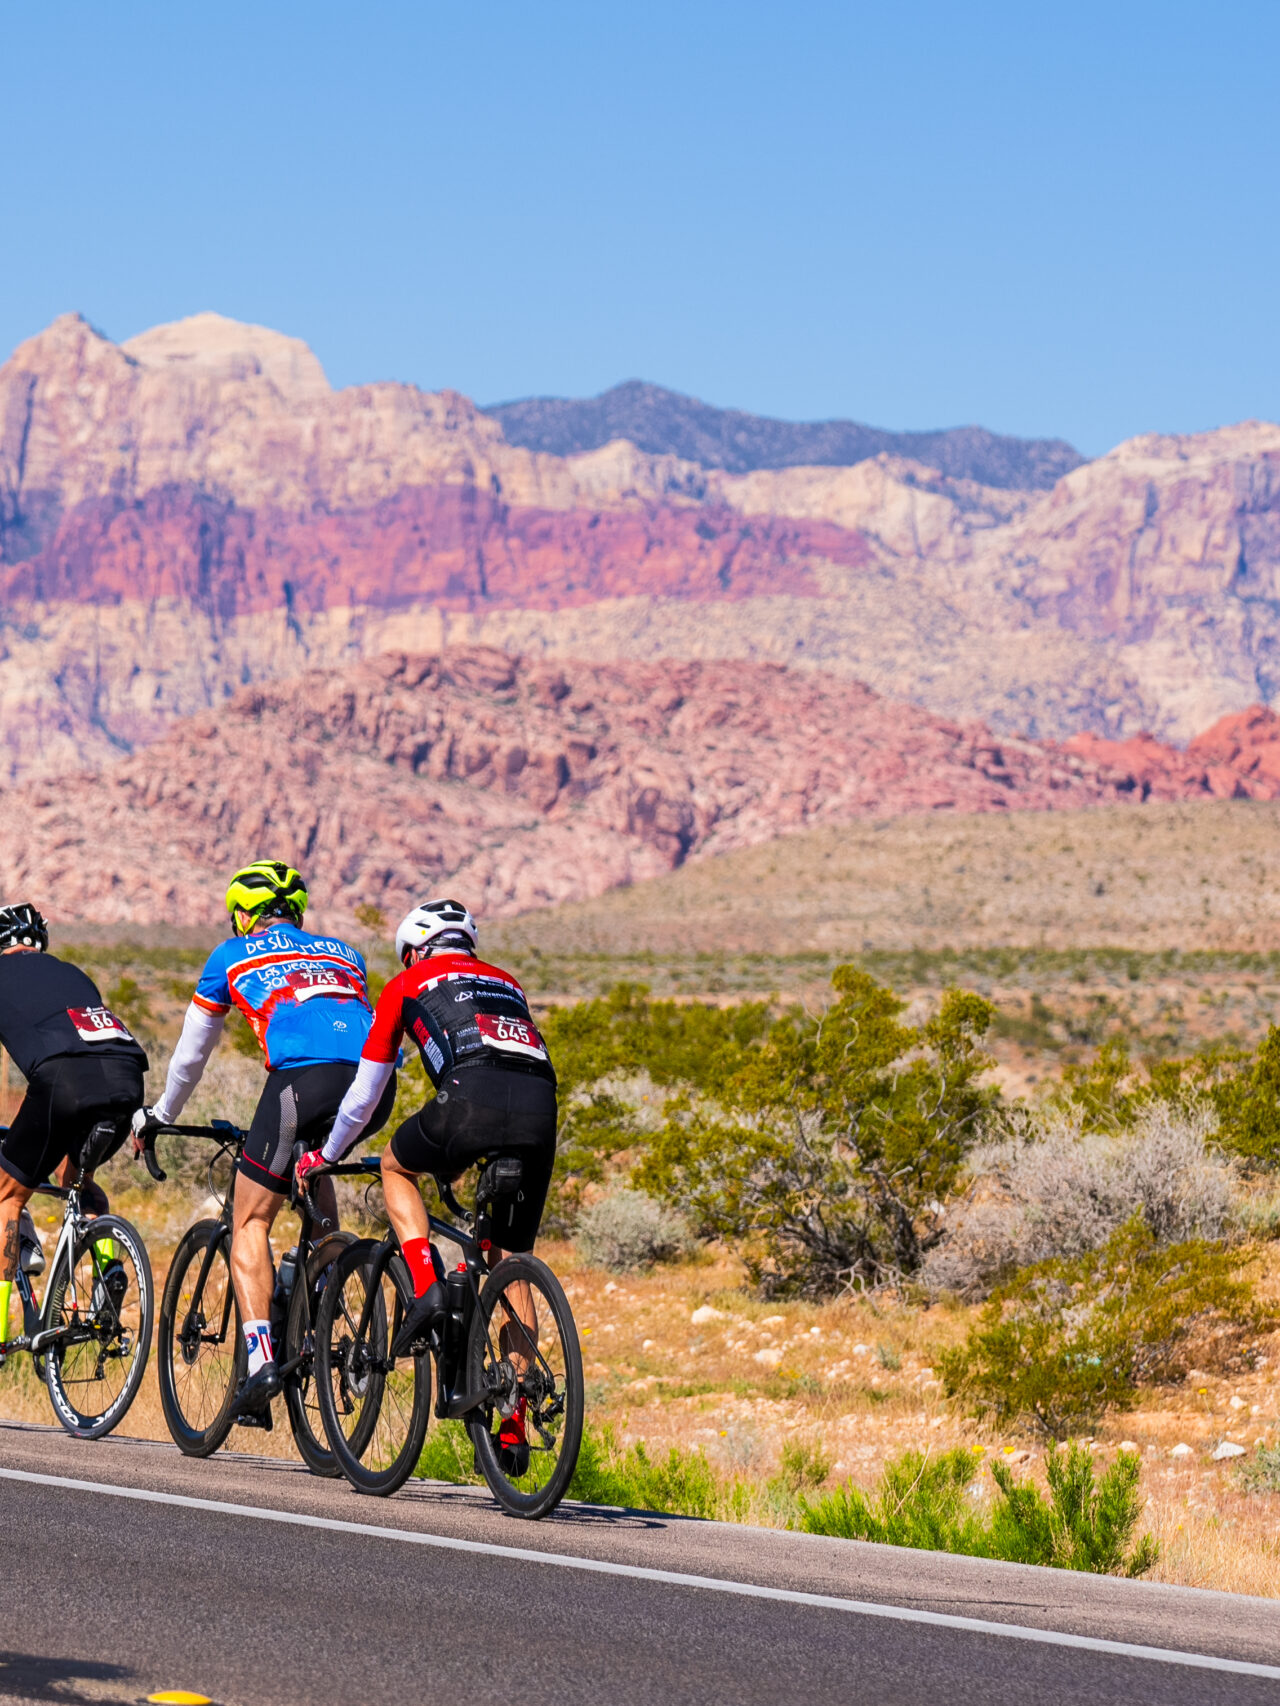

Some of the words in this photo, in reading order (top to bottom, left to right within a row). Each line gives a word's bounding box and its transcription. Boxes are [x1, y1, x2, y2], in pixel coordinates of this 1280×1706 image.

[245, 940, 267, 955] DE
[257, 966, 280, 982] LAS
[282, 961, 325, 973] VEGAS
[302, 972, 339, 986] 745
[264, 975, 287, 990] 201
[90, 1013, 114, 1029] 86
[497, 1023, 530, 1043] 645
